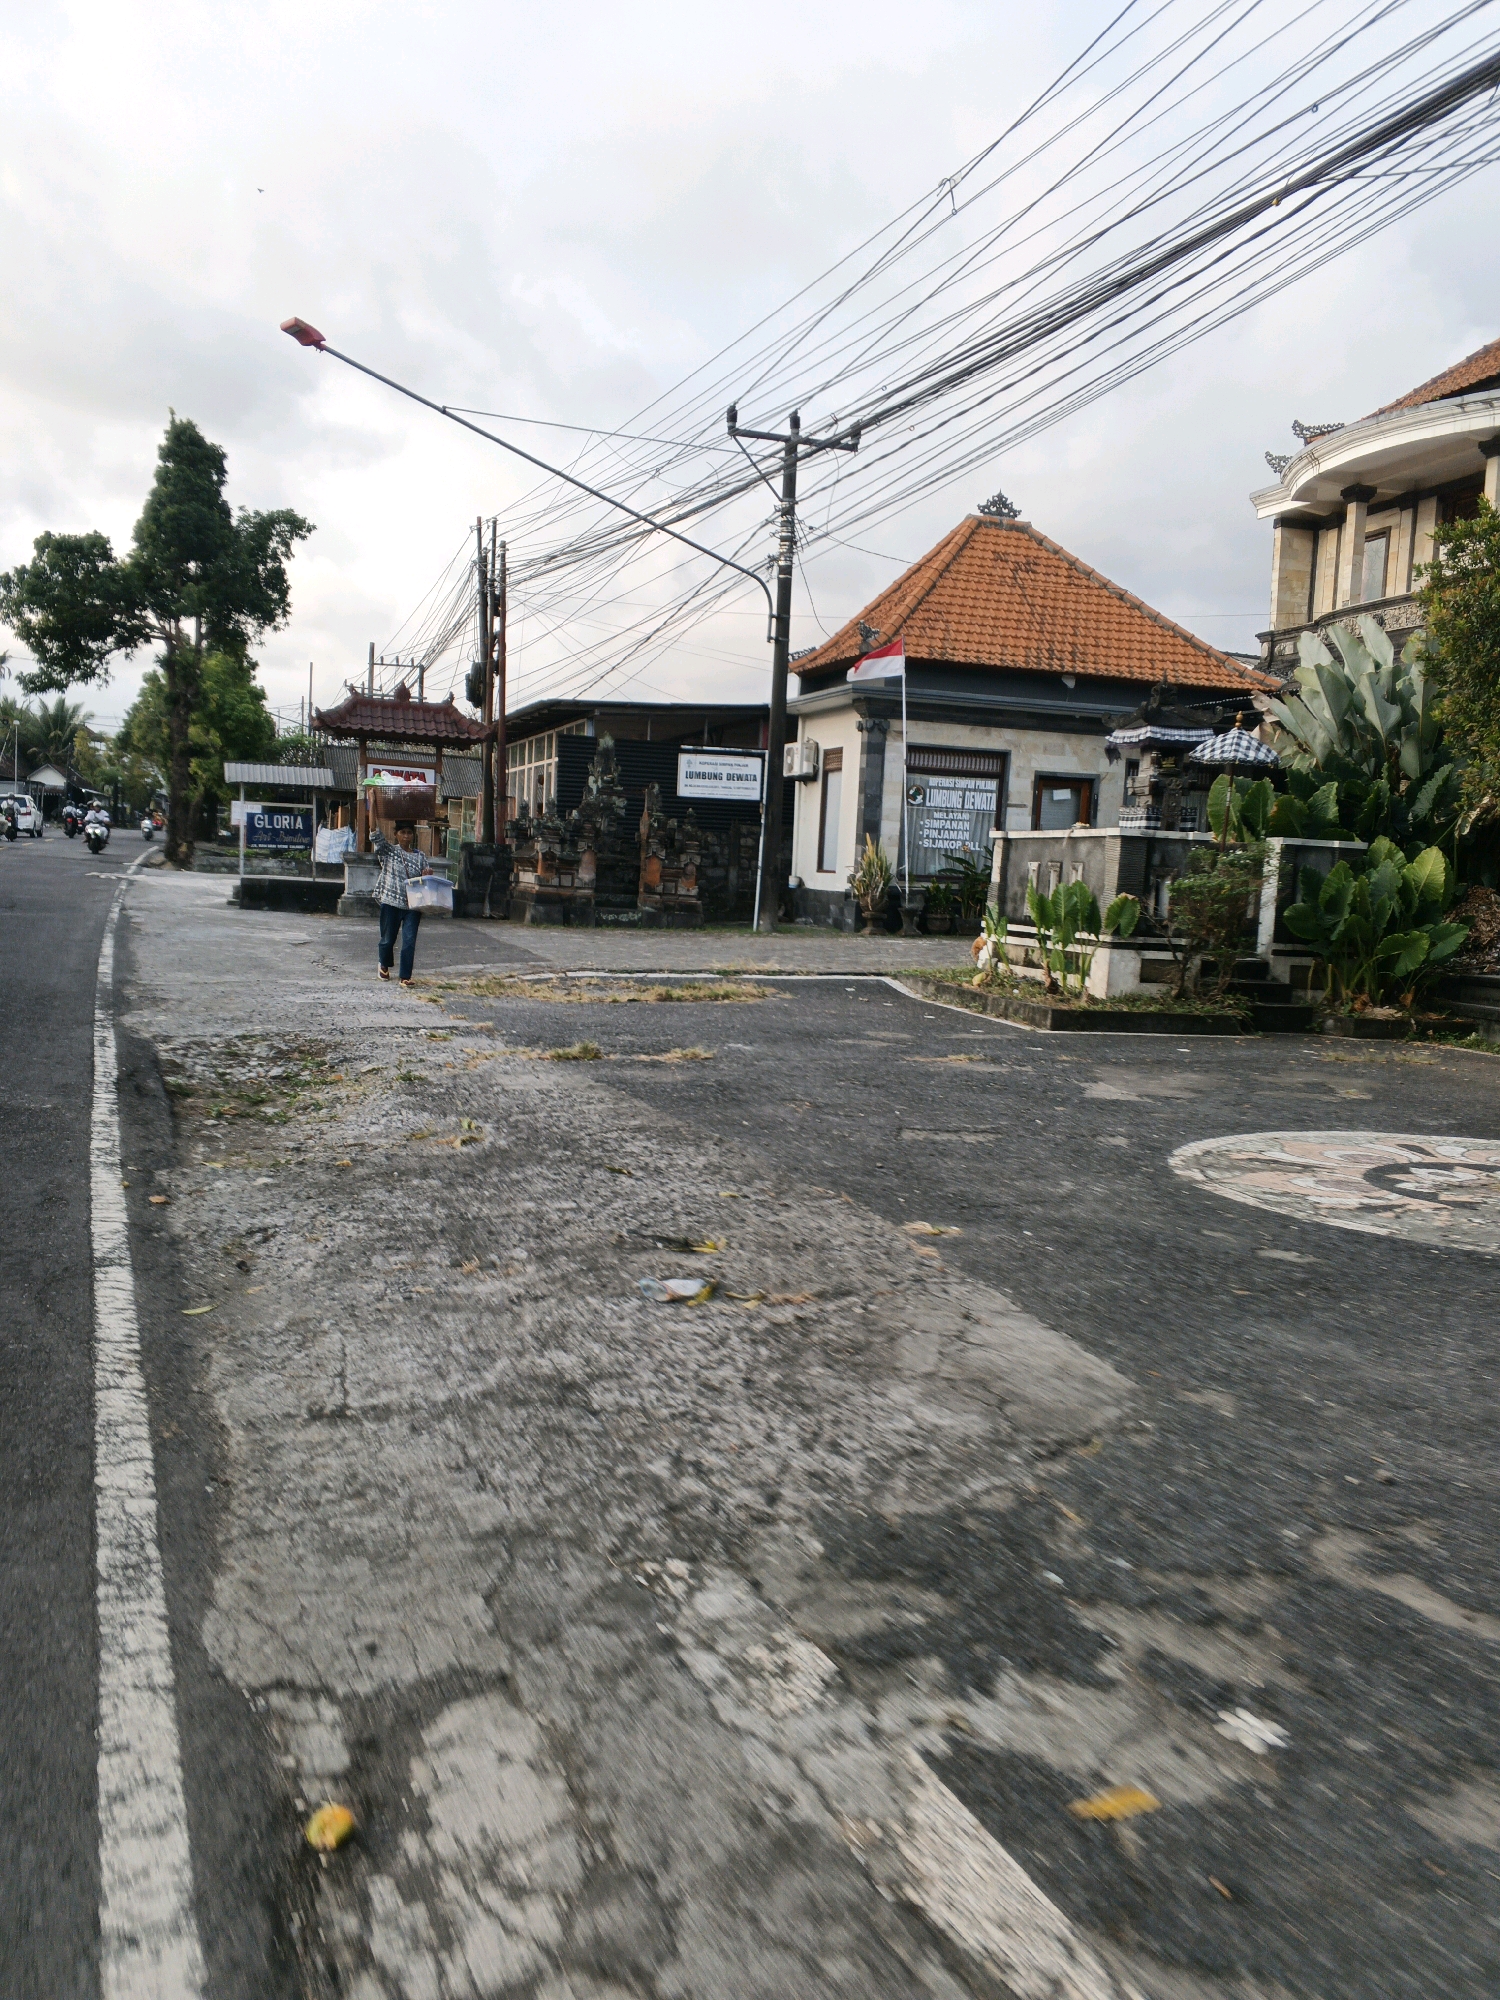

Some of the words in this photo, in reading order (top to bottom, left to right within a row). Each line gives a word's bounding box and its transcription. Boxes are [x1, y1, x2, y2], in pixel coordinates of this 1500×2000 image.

[685, 770, 723, 781] LUMBUNG
[726, 773, 757, 782] DEWATA
[929, 777, 955, 787] KOPERASI
[955, 779, 975, 789] SIMPAN
[975, 780, 997, 790] PINJAM
[926, 788, 962, 808] LUMBUNG
[964, 791, 996, 811] DEWATA
[933, 811, 970, 820] MELAYANI
[254, 814, 303, 829] GLORIA
[924, 819, 970, 830] SIMPANAN
[923, 829, 970, 840] PINJAMAN
[923, 839, 962, 850] SIJAKOP
